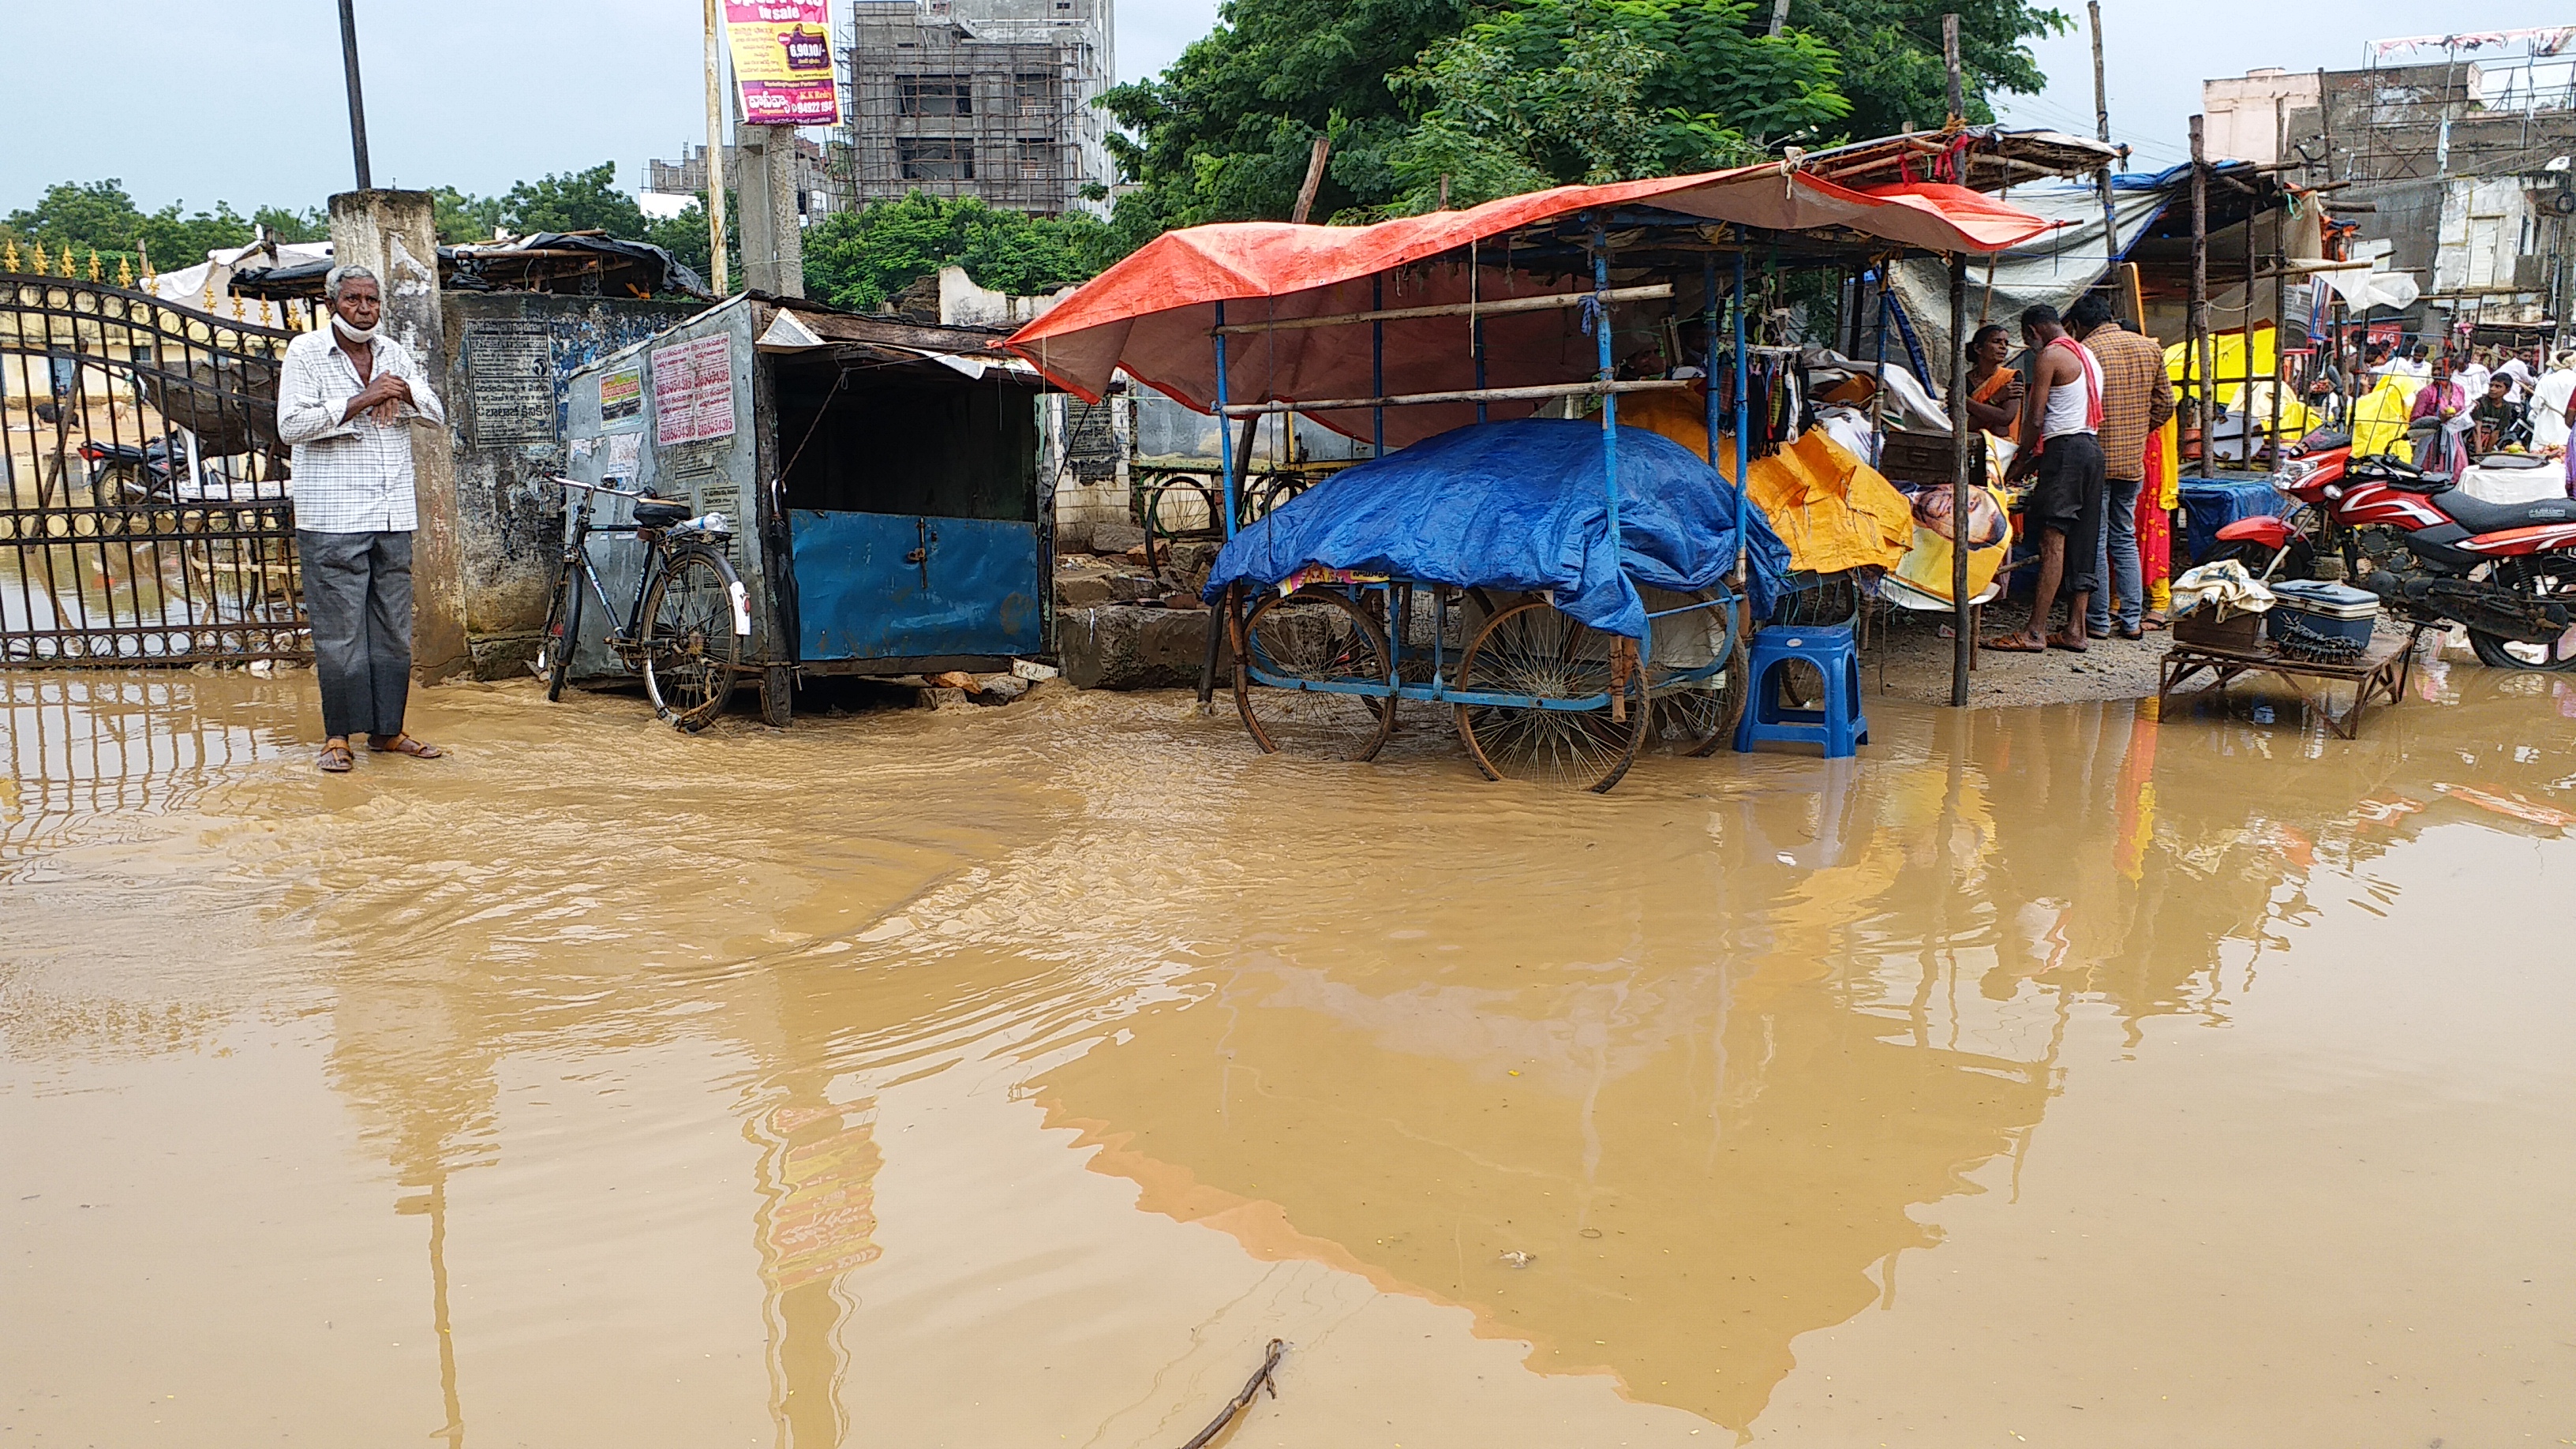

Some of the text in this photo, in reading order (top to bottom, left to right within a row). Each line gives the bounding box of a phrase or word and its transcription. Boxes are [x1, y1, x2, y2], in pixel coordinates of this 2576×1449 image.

[773, 5, 800, 20] sale
[485, 405, 543, 419] బాలాజీ క్లినిక్
